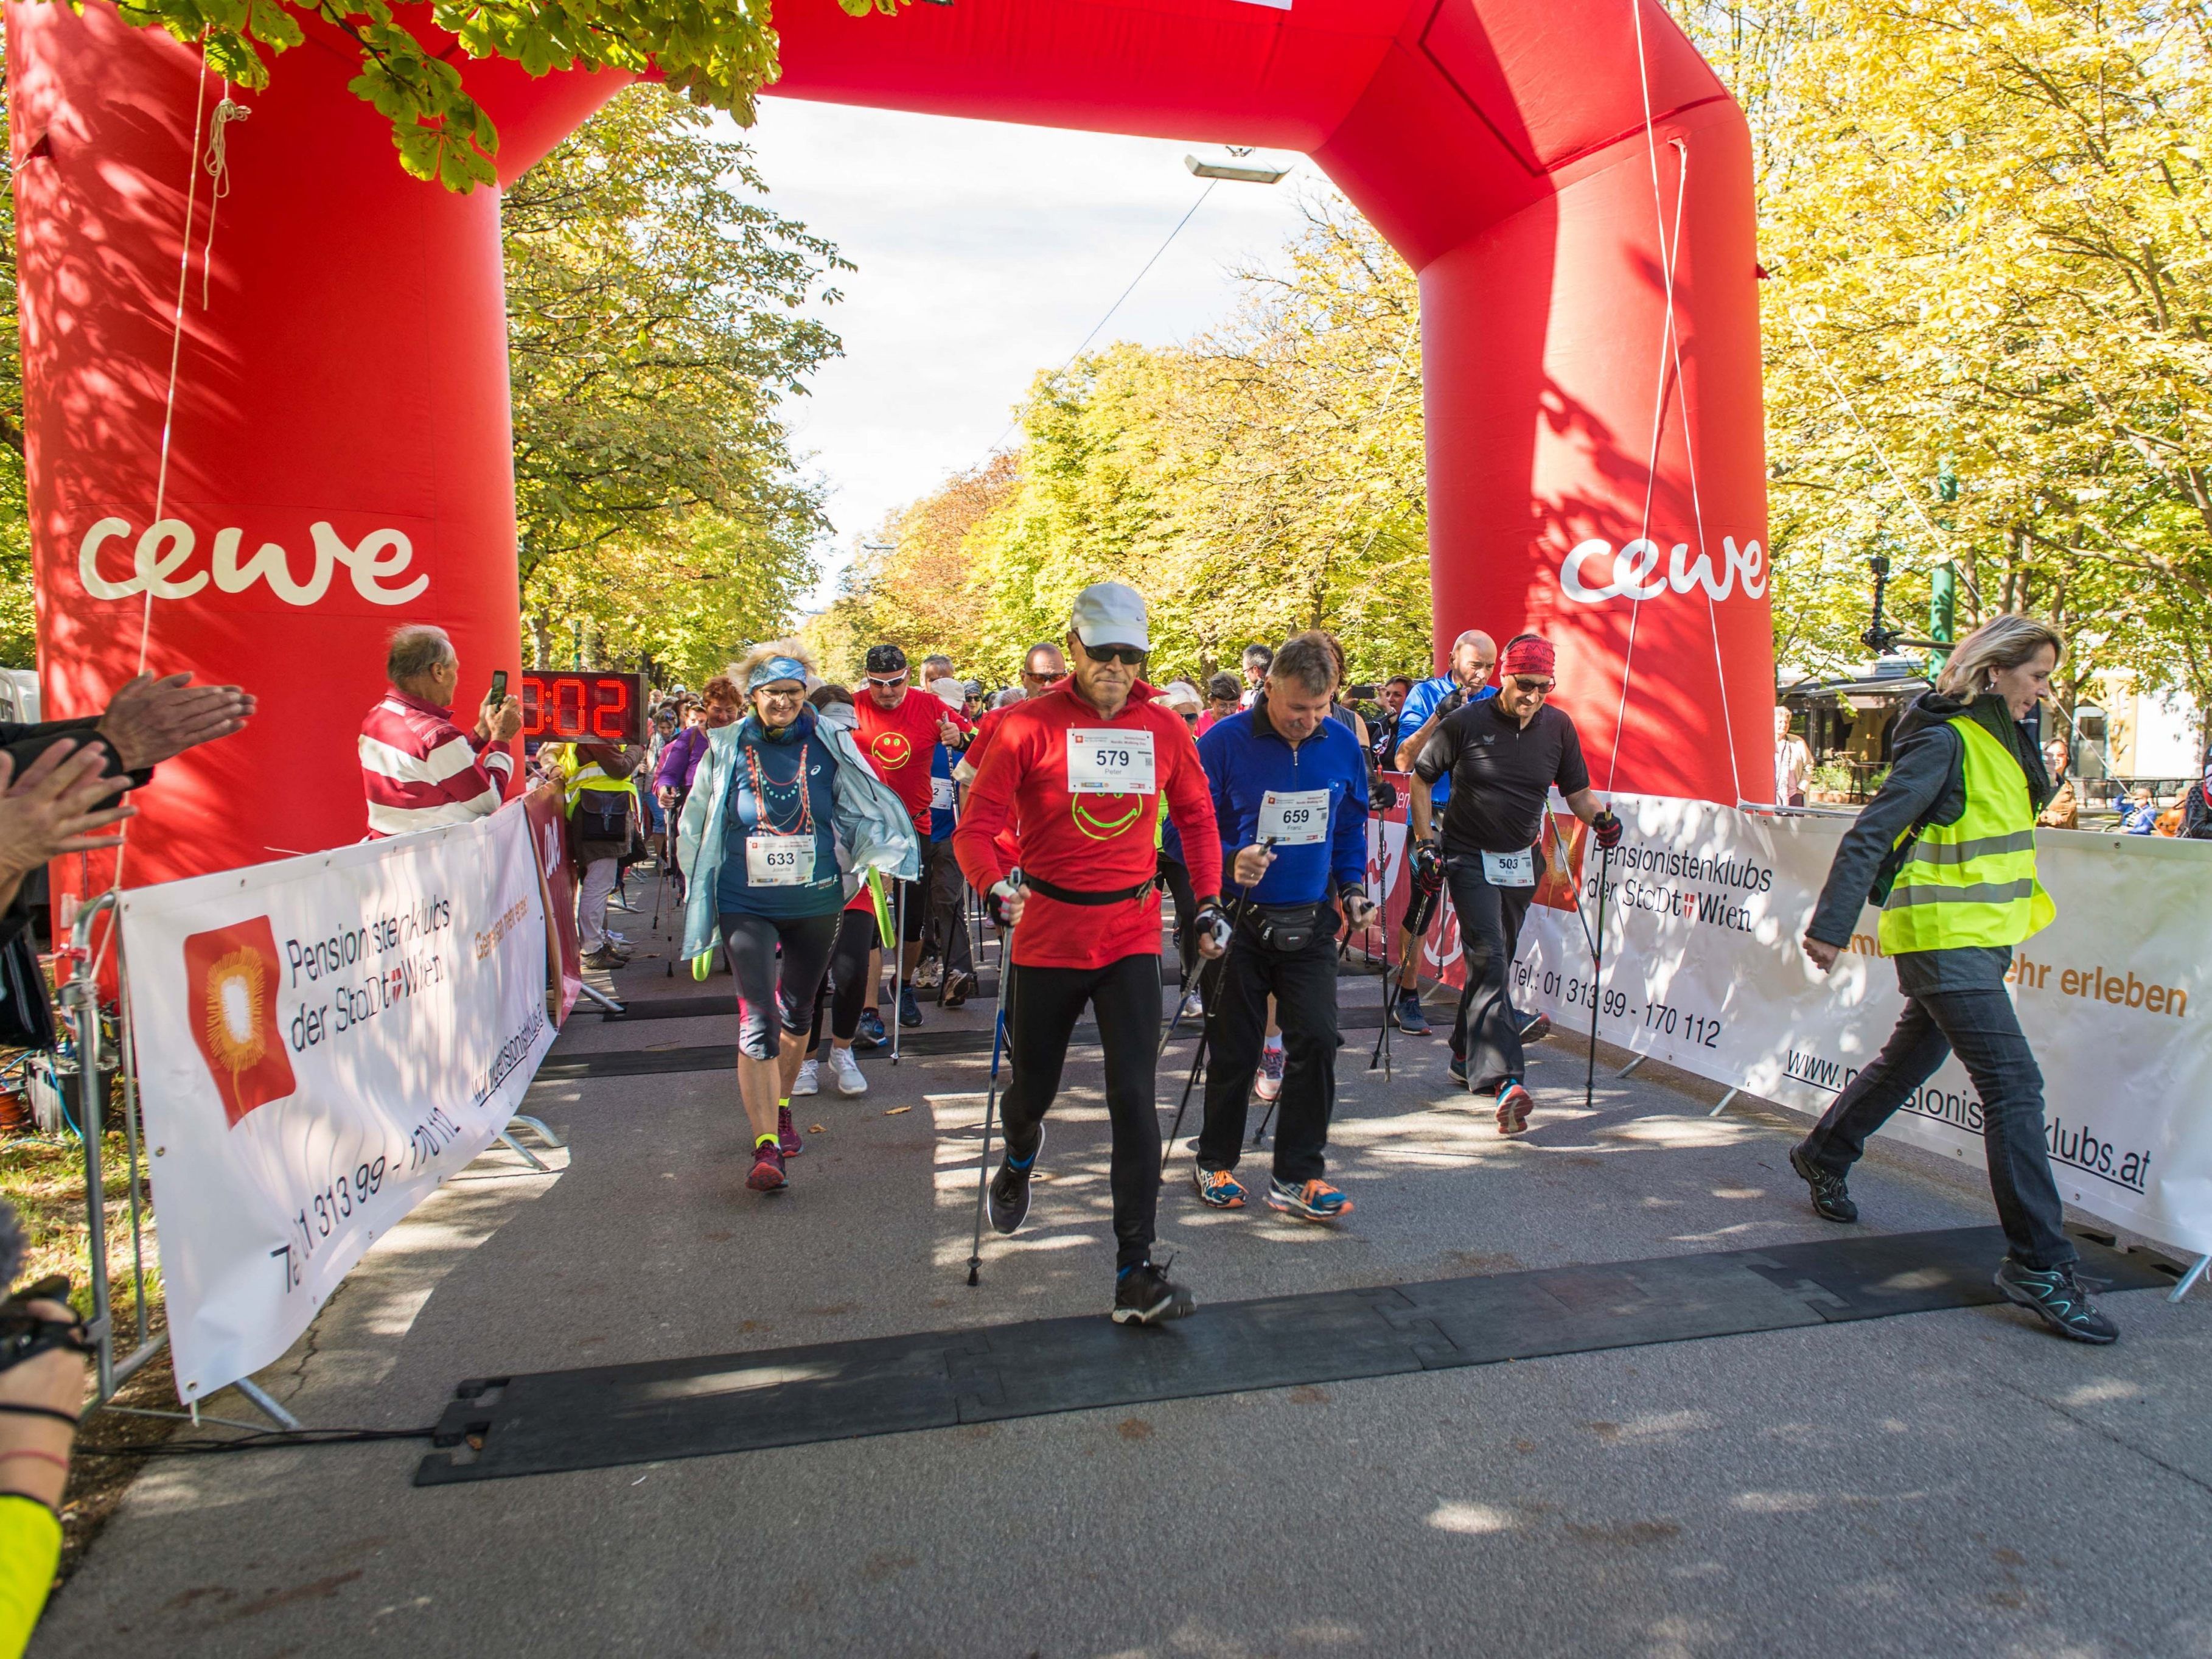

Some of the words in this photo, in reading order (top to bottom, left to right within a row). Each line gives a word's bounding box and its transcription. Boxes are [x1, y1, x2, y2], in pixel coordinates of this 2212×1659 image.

[79, 517, 430, 606] cewe
[1560, 536, 1767, 603] cewe
[1096, 750, 1129, 766] 579
[1283, 809, 1309, 823] 659
[767, 853, 794, 865] 633
[1499, 859, 1518, 869] 503
[286, 894, 450, 988] Pensionistenklubs
[1698, 892, 1752, 932] Wien
[1544, 971, 1561, 997] 01
[1566, 979, 1599, 1009] 313
[1603, 990, 1626, 1018] 99
[1645, 1002, 1677, 1035] 170
[1684, 1013, 1721, 1049] 112
[2003, 952, 2051, 989] ehr
[2060, 966, 2188, 1018] erleben
[291, 1002, 327, 1052] der
[314, 1176, 351, 1237] 313
[356, 1156, 385, 1204] 99
[411, 1125, 439, 1170] 170
[426, 1107, 461, 1144] 112
